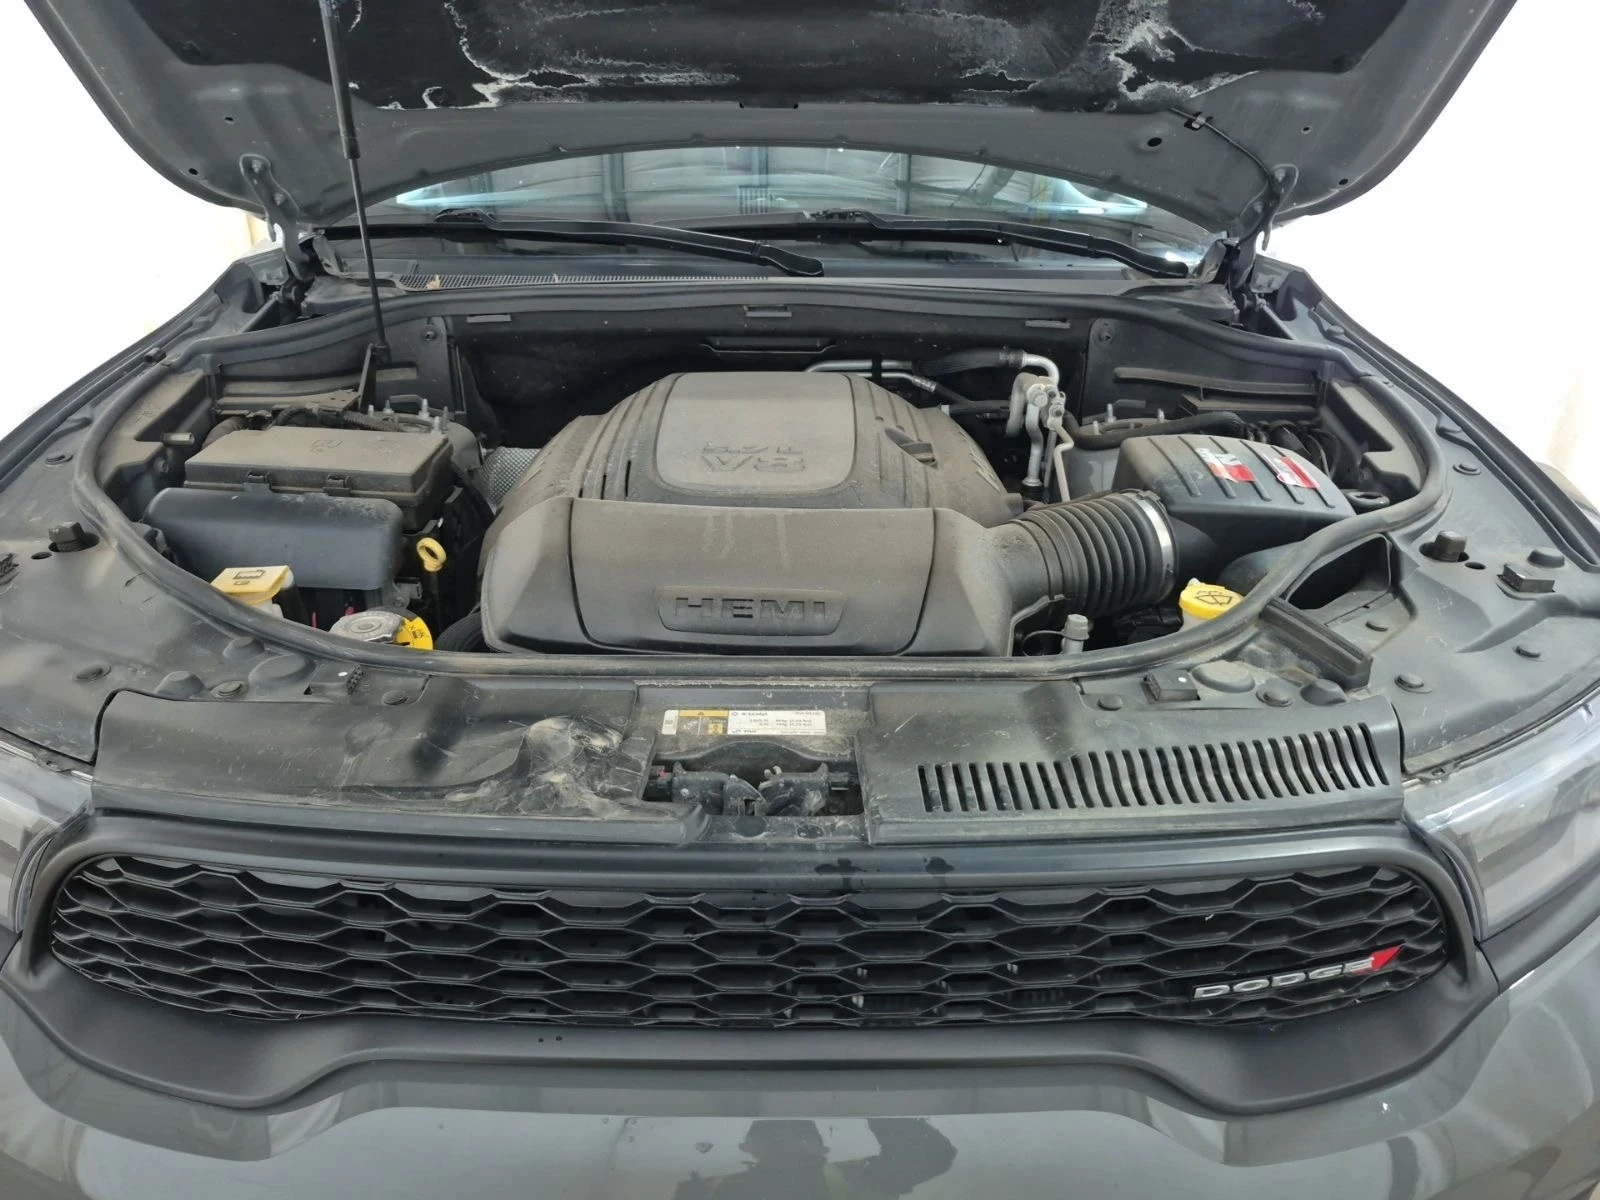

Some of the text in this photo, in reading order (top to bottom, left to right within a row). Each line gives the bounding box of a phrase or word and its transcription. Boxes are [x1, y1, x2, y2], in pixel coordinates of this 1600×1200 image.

[703, 455, 806, 472] V8
[675, 597, 826, 620] HEMI
[1194, 956, 1376, 999] DODGE
